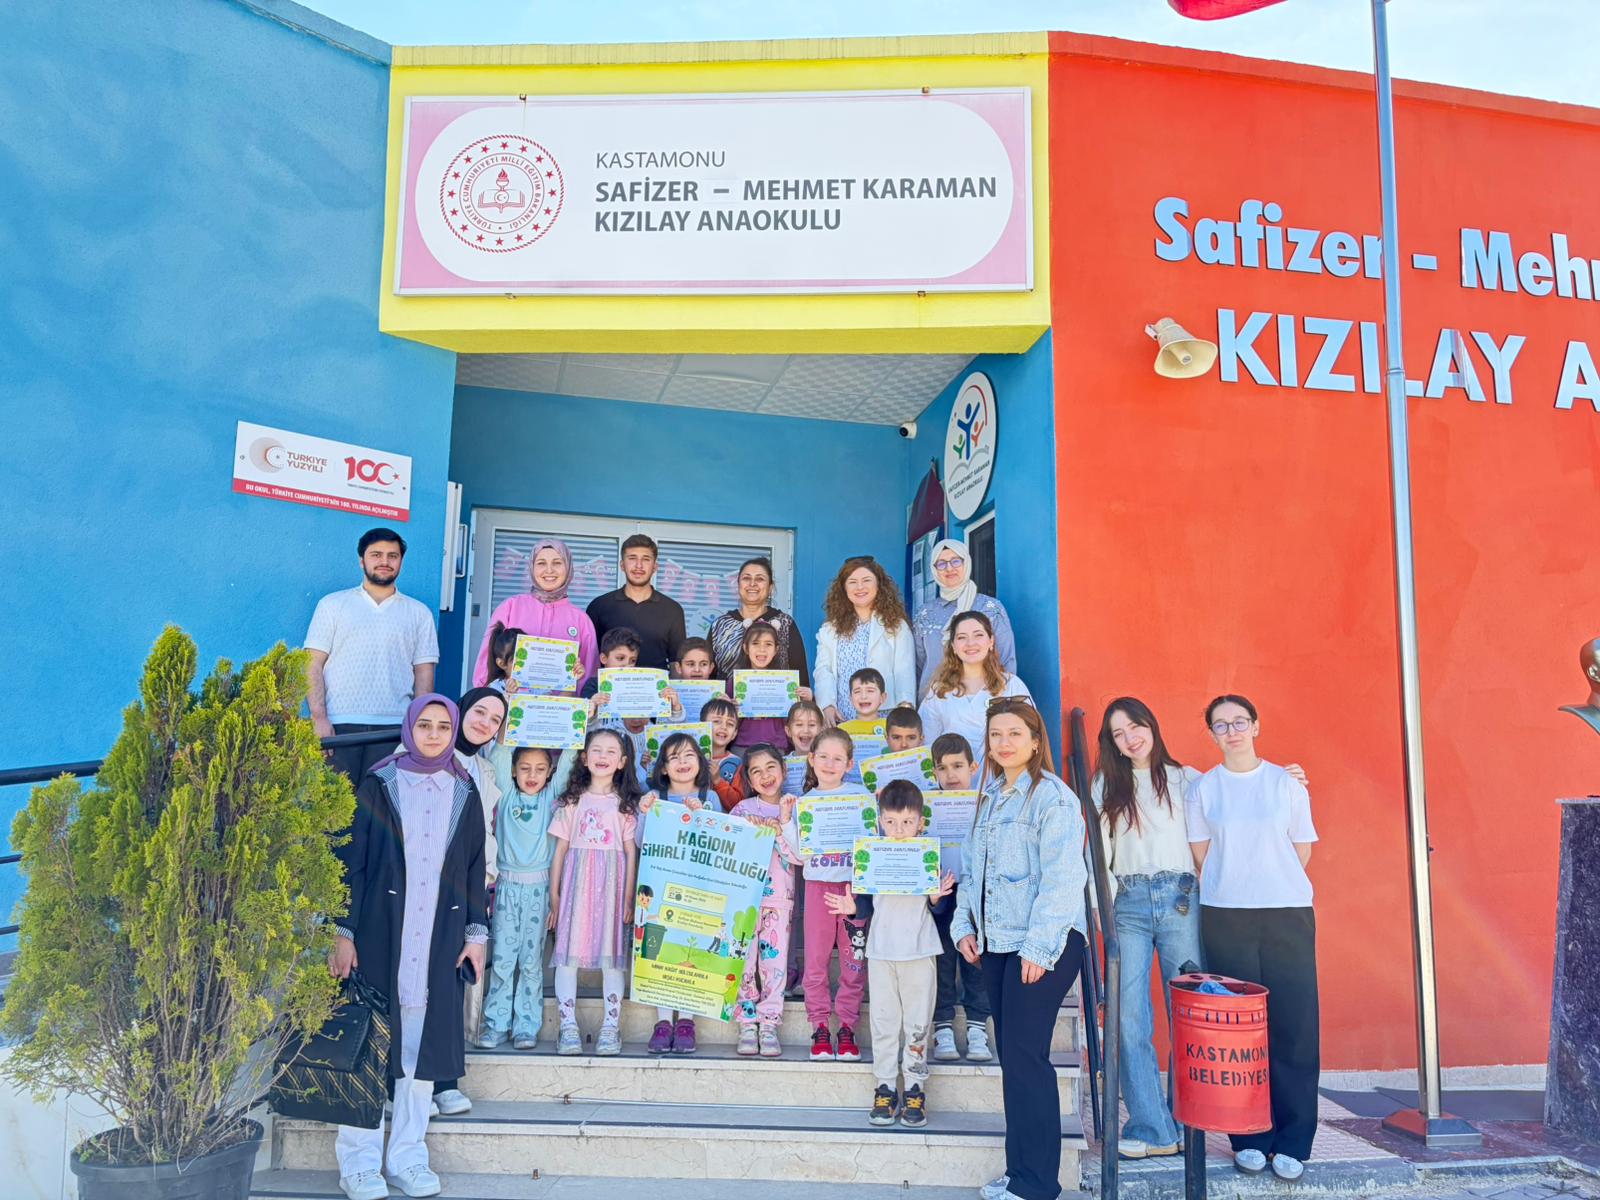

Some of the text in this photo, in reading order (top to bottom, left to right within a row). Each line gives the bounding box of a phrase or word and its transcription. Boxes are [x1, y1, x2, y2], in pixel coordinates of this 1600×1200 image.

[596, 151, 726, 169] KASTAMONU
[595, 177, 699, 202] SAFİZER
[743, 179, 856, 201] MEHMET
[863, 177, 997, 200] KARAMAN
[595, 209, 841, 232] KIZILAY ANAOKULU
[1154, 196, 1382, 280] Safizer
[677, 829, 736, 856] KAĞIDIN
[689, 848, 768, 883] YOLCULUĞU
[1186, 1042, 1268, 1064] KASTAMON
